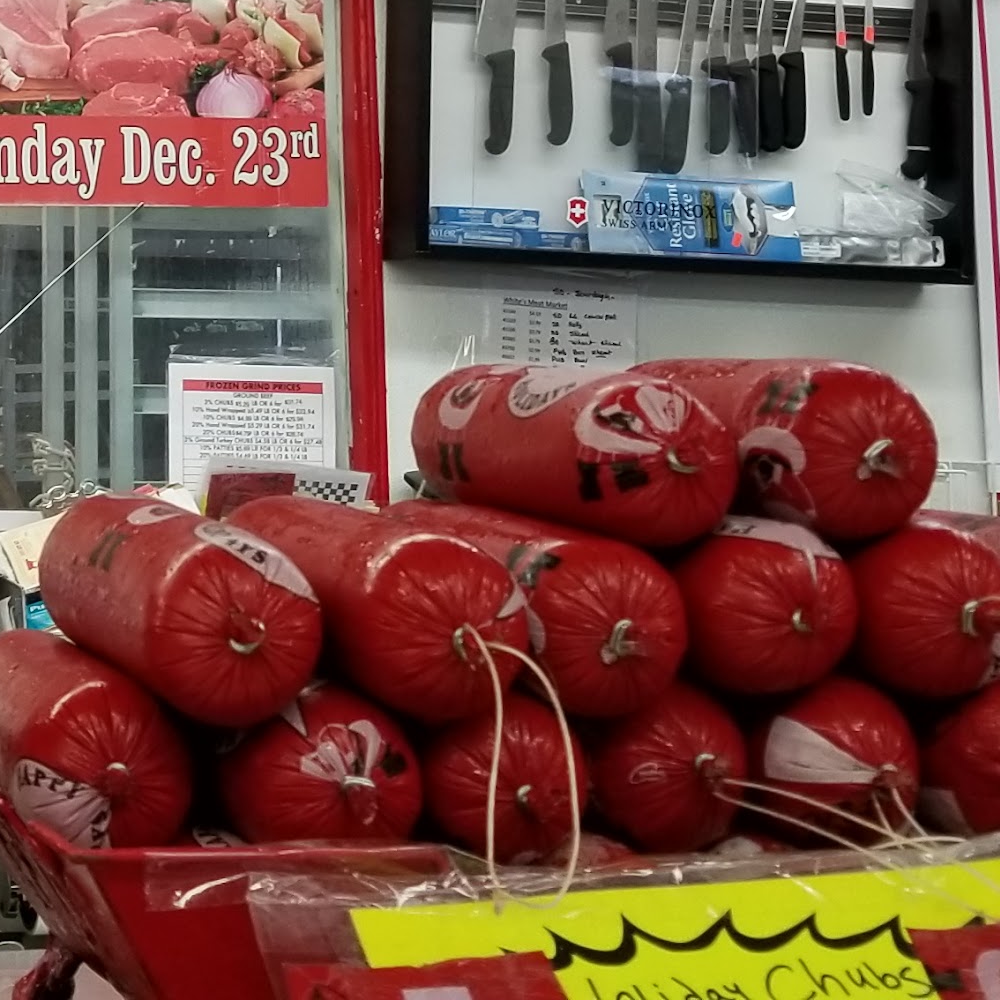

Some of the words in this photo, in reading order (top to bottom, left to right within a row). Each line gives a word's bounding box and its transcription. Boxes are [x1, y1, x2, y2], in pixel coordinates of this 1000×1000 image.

[120, 125, 216, 186] Dec.
[231, 121, 321, 187] 23rd
[601, 198, 717, 220] VICTORINOX
[601, 218, 637, 229] SWISS
[641, 219, 676, 231] ARMY
[206, 381, 239, 390] FROZEN
[242, 382, 271, 391] GRIND
[273, 383, 301, 392] PRICES
[766, 958, 932, 1000] Chubs
